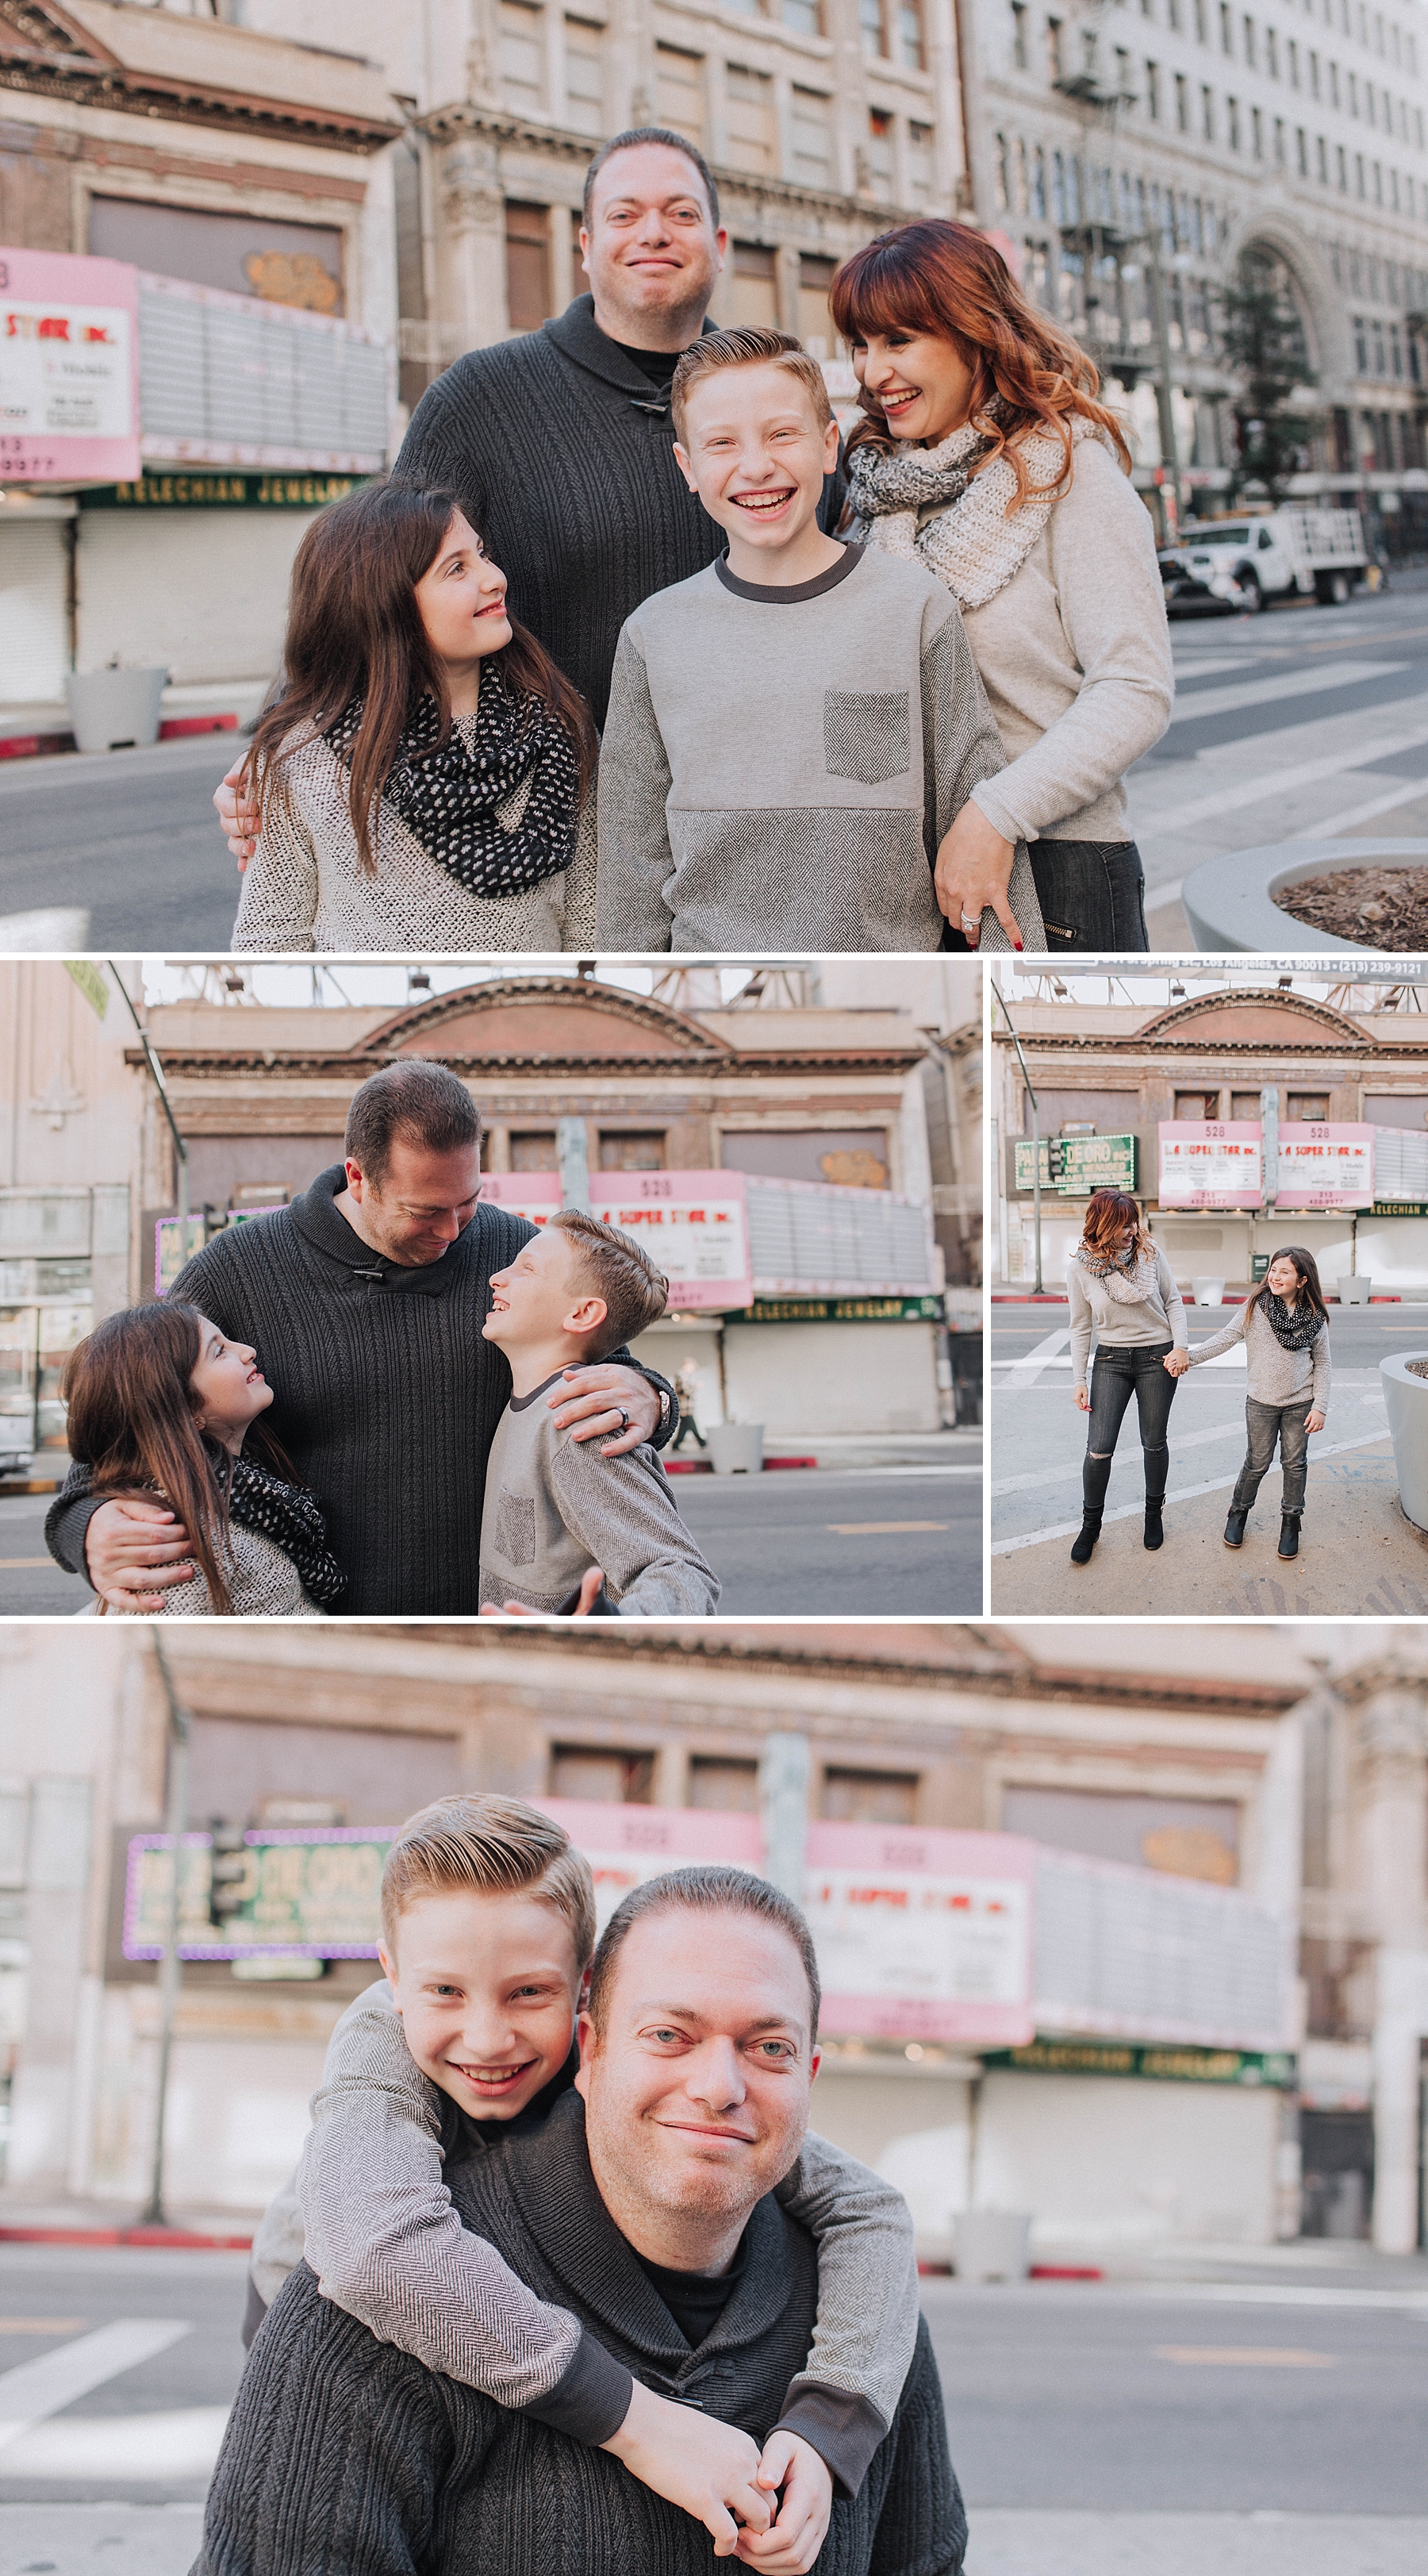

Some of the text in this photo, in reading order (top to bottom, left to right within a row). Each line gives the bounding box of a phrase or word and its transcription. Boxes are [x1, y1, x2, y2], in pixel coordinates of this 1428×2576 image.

[1276, 960, 1293, 970] CA
[1296, 960, 1330, 971] 90013
[1339, 960, 1368, 973] (213)
[1369, 962, 1421, 975] 239-9121
[1206, 1127, 1225, 1136] 528
[1311, 1128, 1330, 1137] 528
[1218, 1145, 1240, 1155] STAR
[1296, 1146, 1323, 1155] SUPER
[1327, 1146, 1349, 1155] STAR
[1370, 1204, 1420, 1215] KELECHIAN
